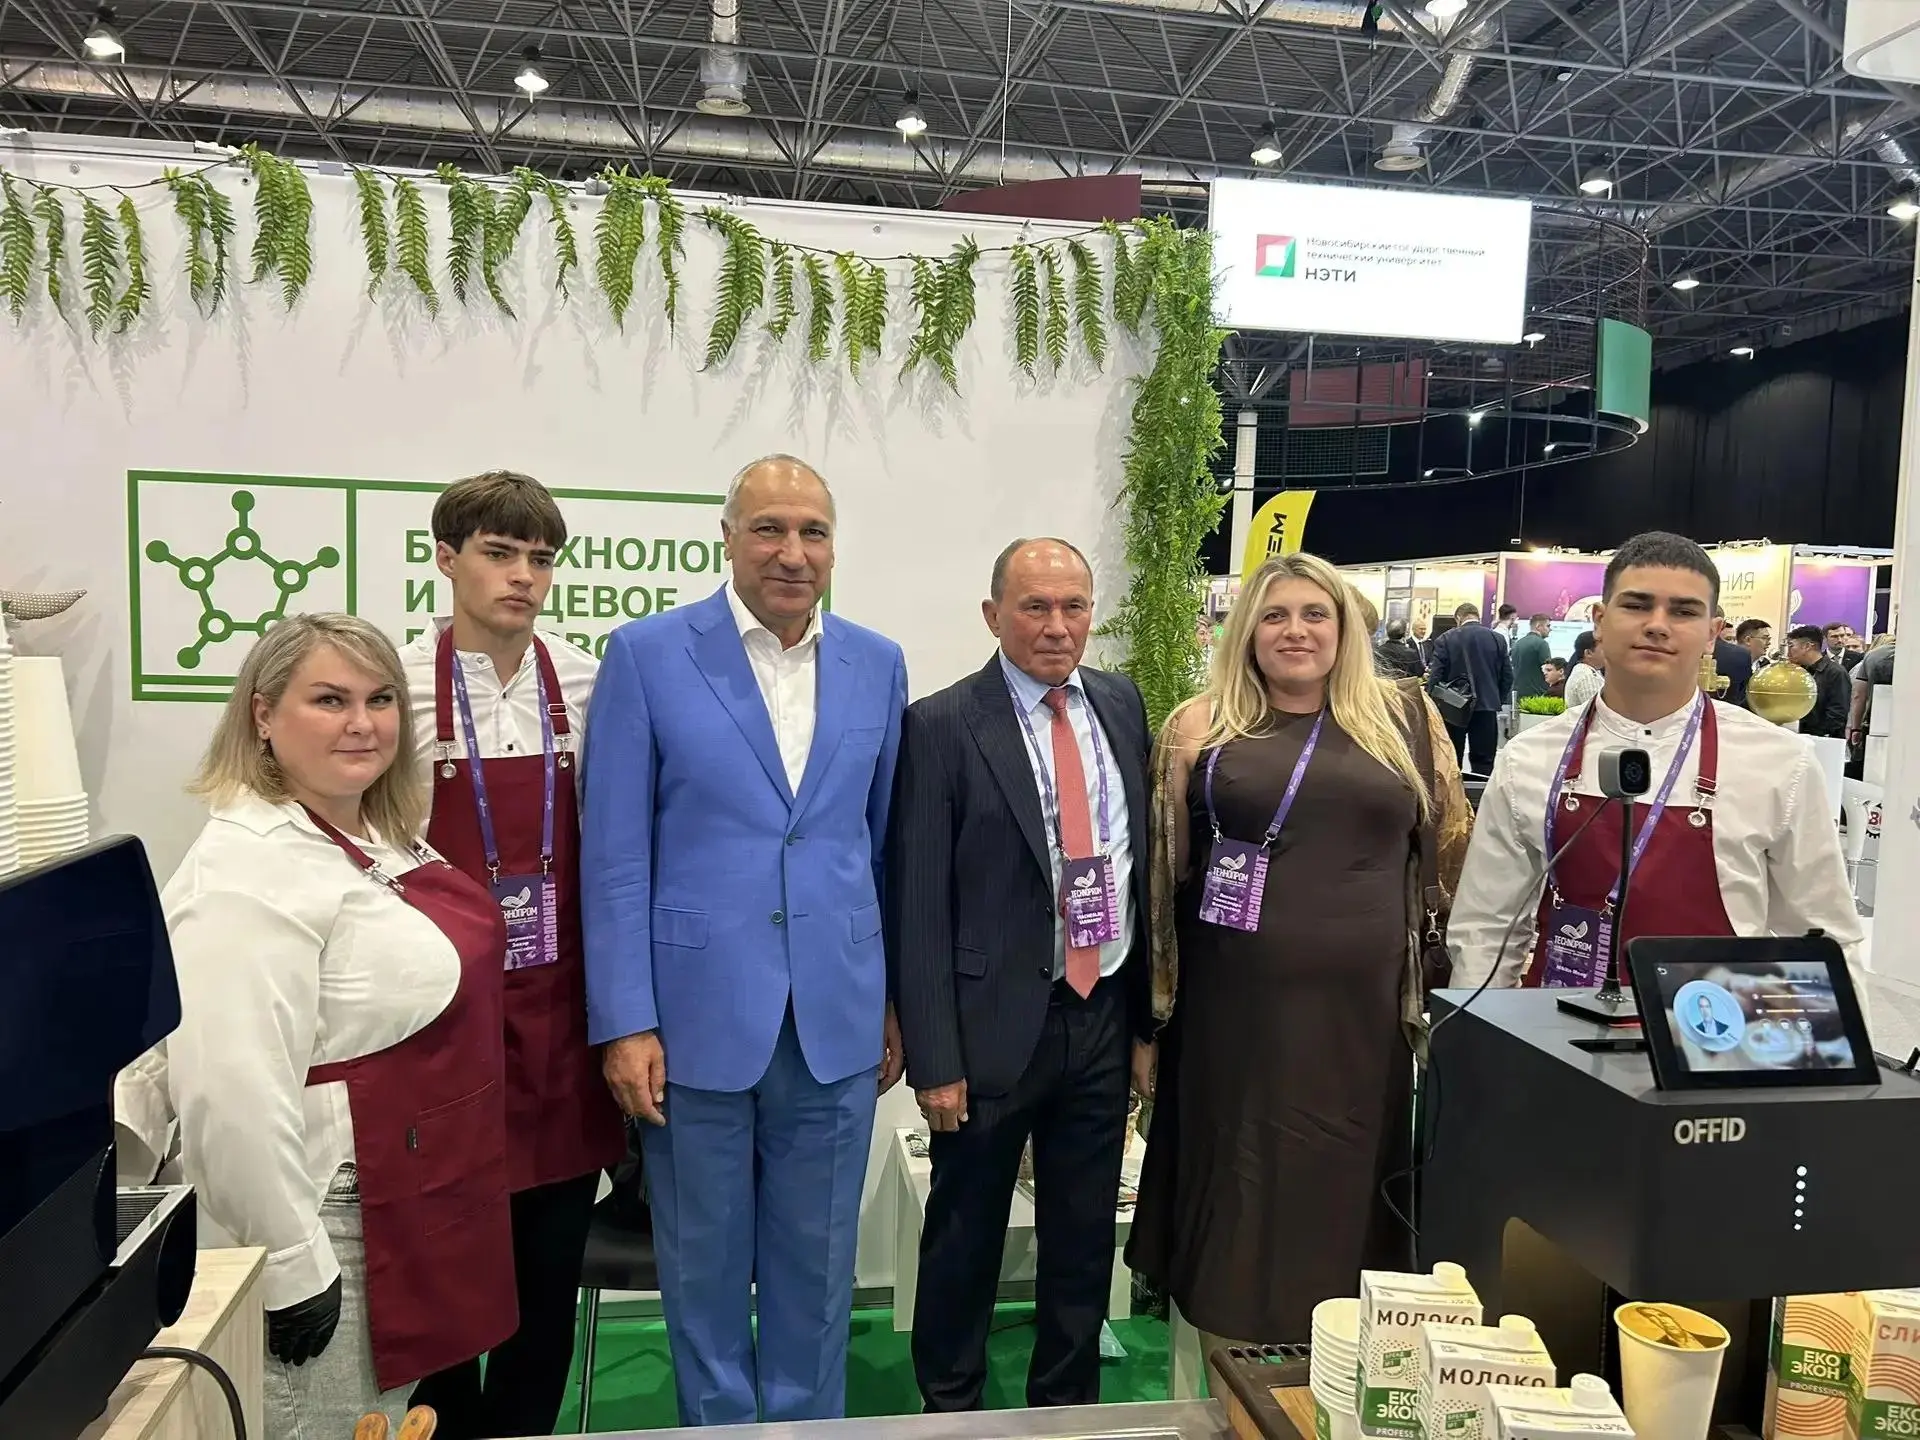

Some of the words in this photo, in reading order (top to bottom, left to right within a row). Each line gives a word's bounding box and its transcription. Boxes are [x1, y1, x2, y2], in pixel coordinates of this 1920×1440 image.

[1305, 268, 1356, 282] НЭТИ
[1265, 512, 1288, 561] EM
[405, 579, 436, 613] И
[1212, 866, 1249, 883] ТЕХНОПРОМ
[1245, 854, 1269, 932] ЭКСПОНЕНТ
[542, 882, 558, 962] ЭКСПОНЕНТ
[1554, 935, 1592, 952] TECHNOPROM
[1673, 1117, 1747, 1145] OFFID
[1790, 1361, 1840, 1380] ЭКОН
